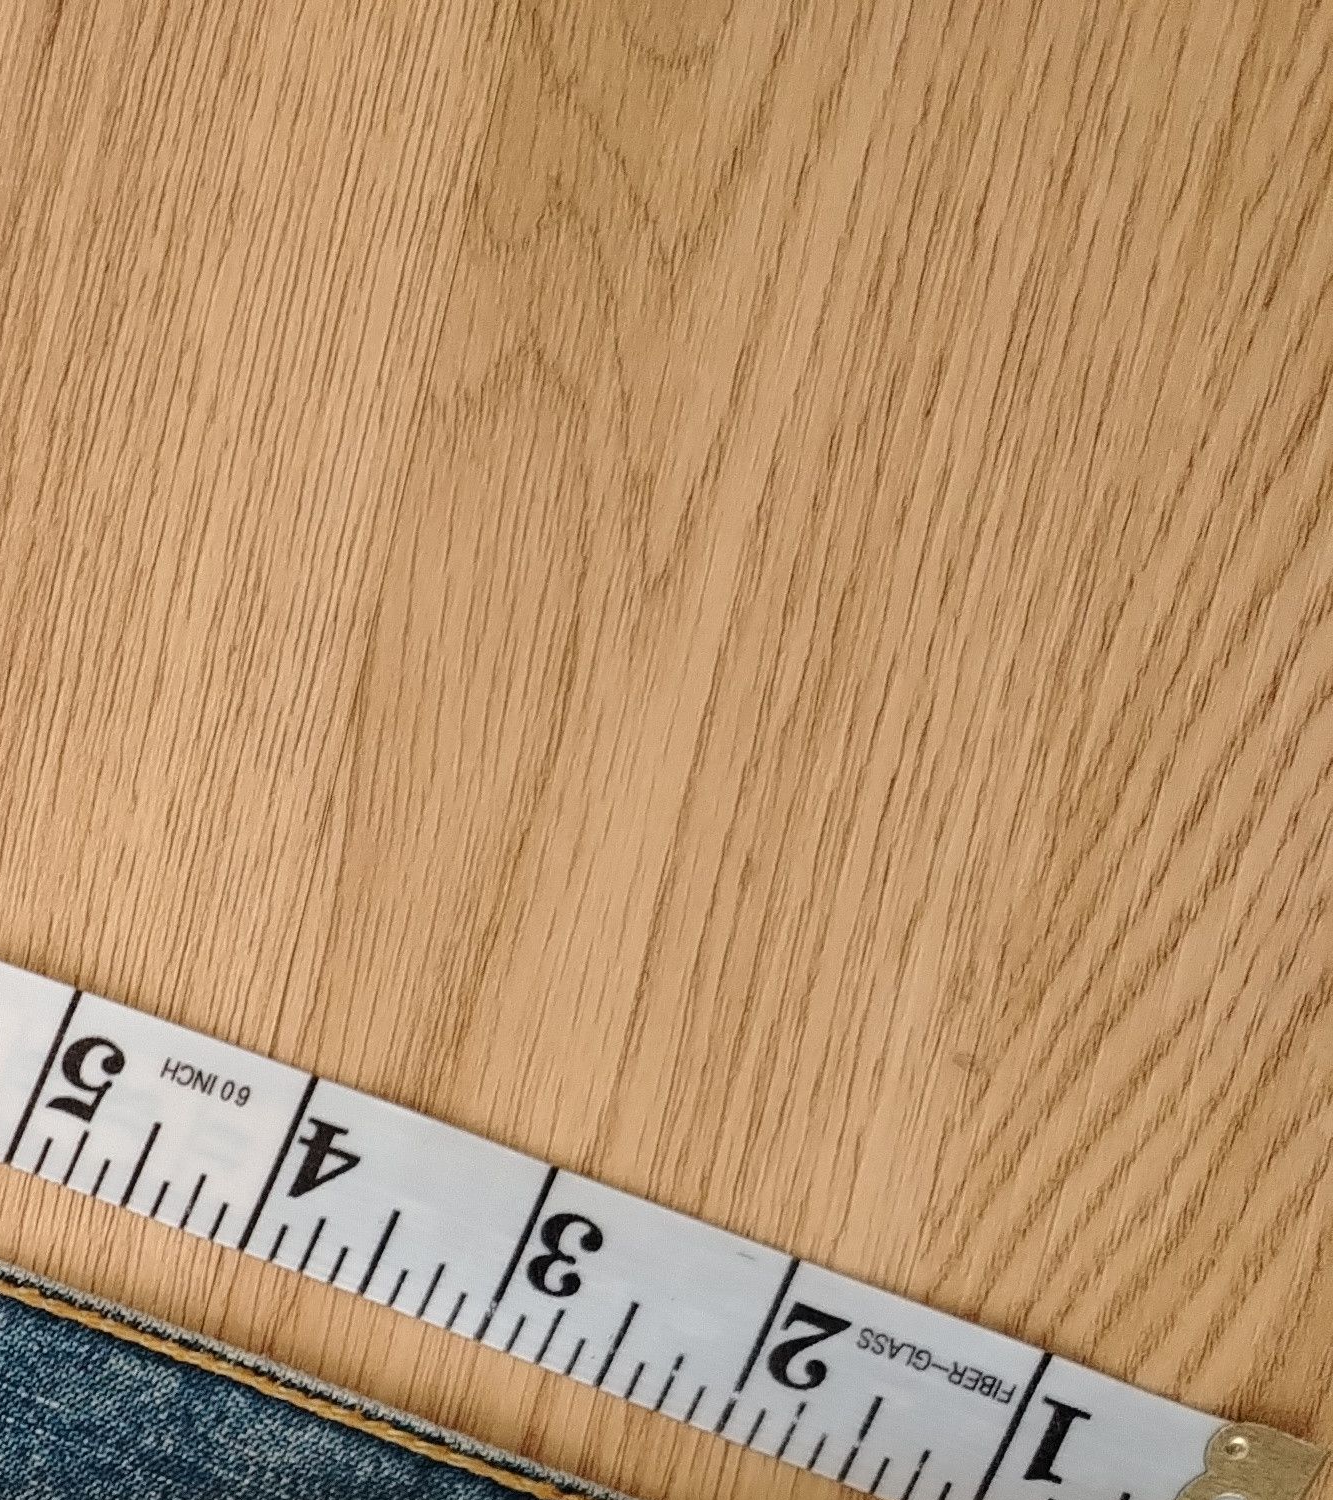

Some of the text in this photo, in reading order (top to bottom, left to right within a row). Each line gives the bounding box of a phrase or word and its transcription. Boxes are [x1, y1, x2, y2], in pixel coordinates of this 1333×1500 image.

[46, 1036, 126, 1123] 5
[160, 1057, 251, 1107] 60 INCH
[287, 1117, 361, 1199] 4
[527, 1212, 603, 1298] 3
[767, 1301, 853, 1391] 2
[856, 1327, 1017, 1405] FIBER-GLASS
[1022, 1396, 1091, 1484] 1
